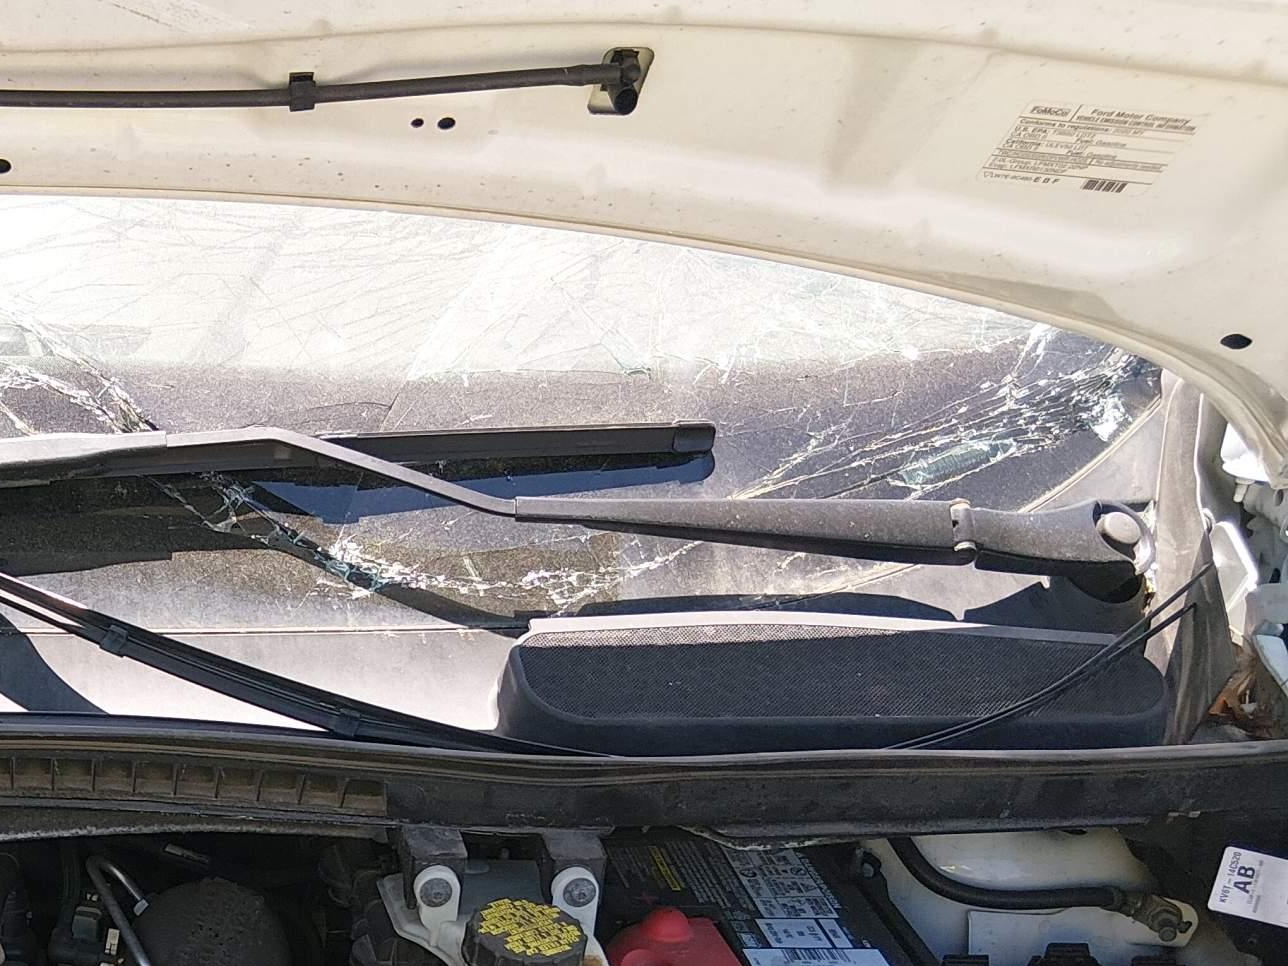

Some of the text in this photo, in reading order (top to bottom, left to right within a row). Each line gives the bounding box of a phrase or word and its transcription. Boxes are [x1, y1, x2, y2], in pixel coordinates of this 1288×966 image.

[1030, 106, 1072, 117] FoMoCo
[1091, 108, 1192, 129] Ford Motor Company
[1233, 865, 1256, 894] AB
